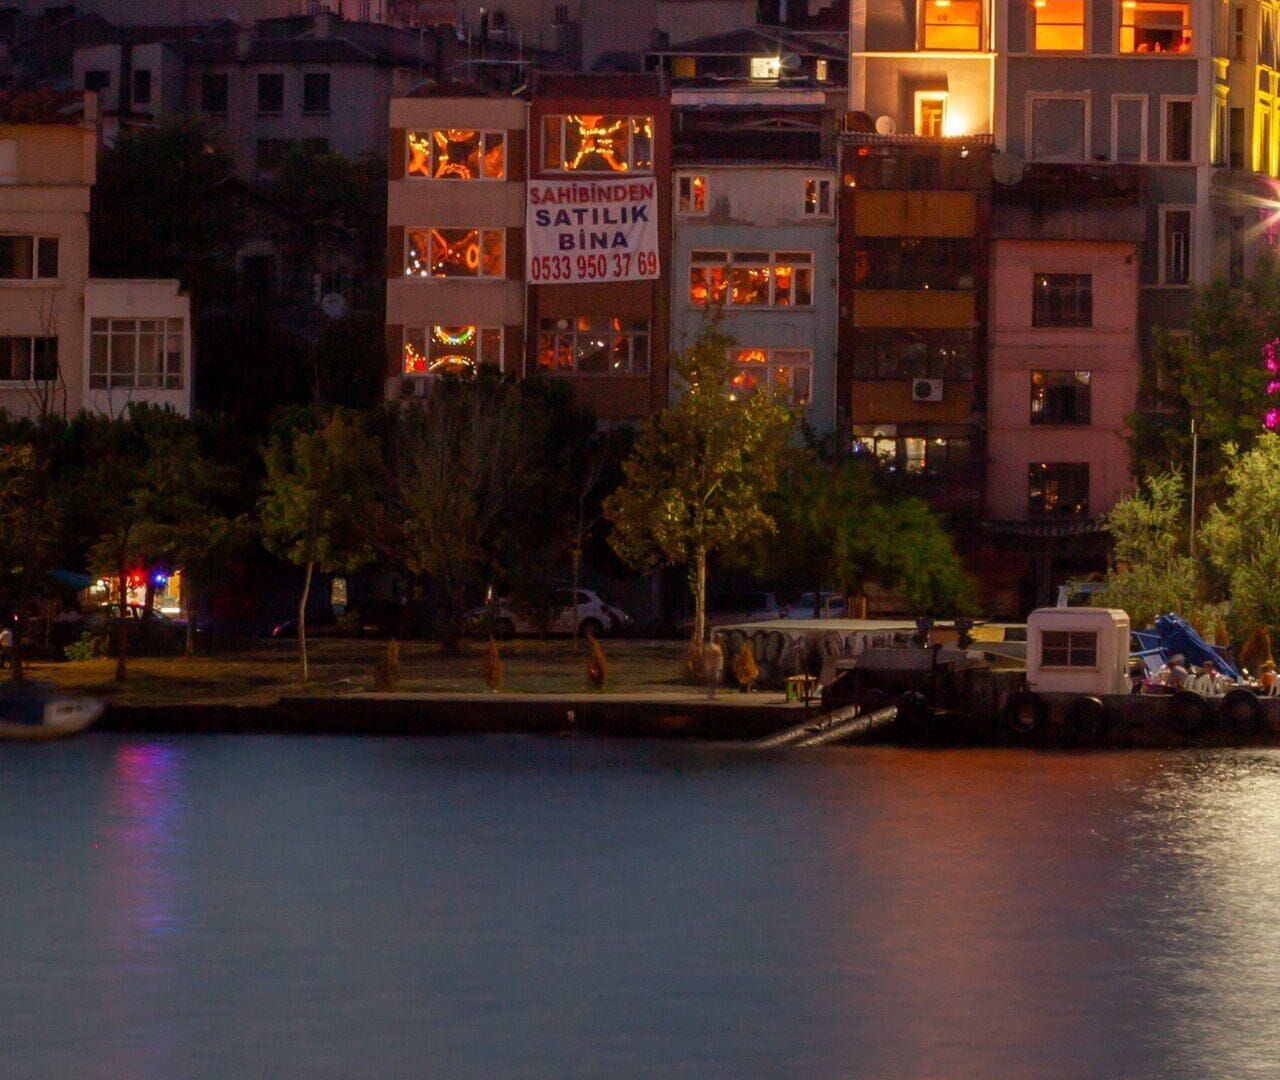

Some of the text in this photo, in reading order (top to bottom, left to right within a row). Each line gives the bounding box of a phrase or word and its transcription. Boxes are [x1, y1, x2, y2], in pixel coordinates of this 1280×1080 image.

[529, 183, 654, 204] SAHİBİNDEN
[535, 205, 649, 226] SATILIK
[558, 229, 629, 250] BİNA
[531, 251, 657, 280] 0533 950 37 69
